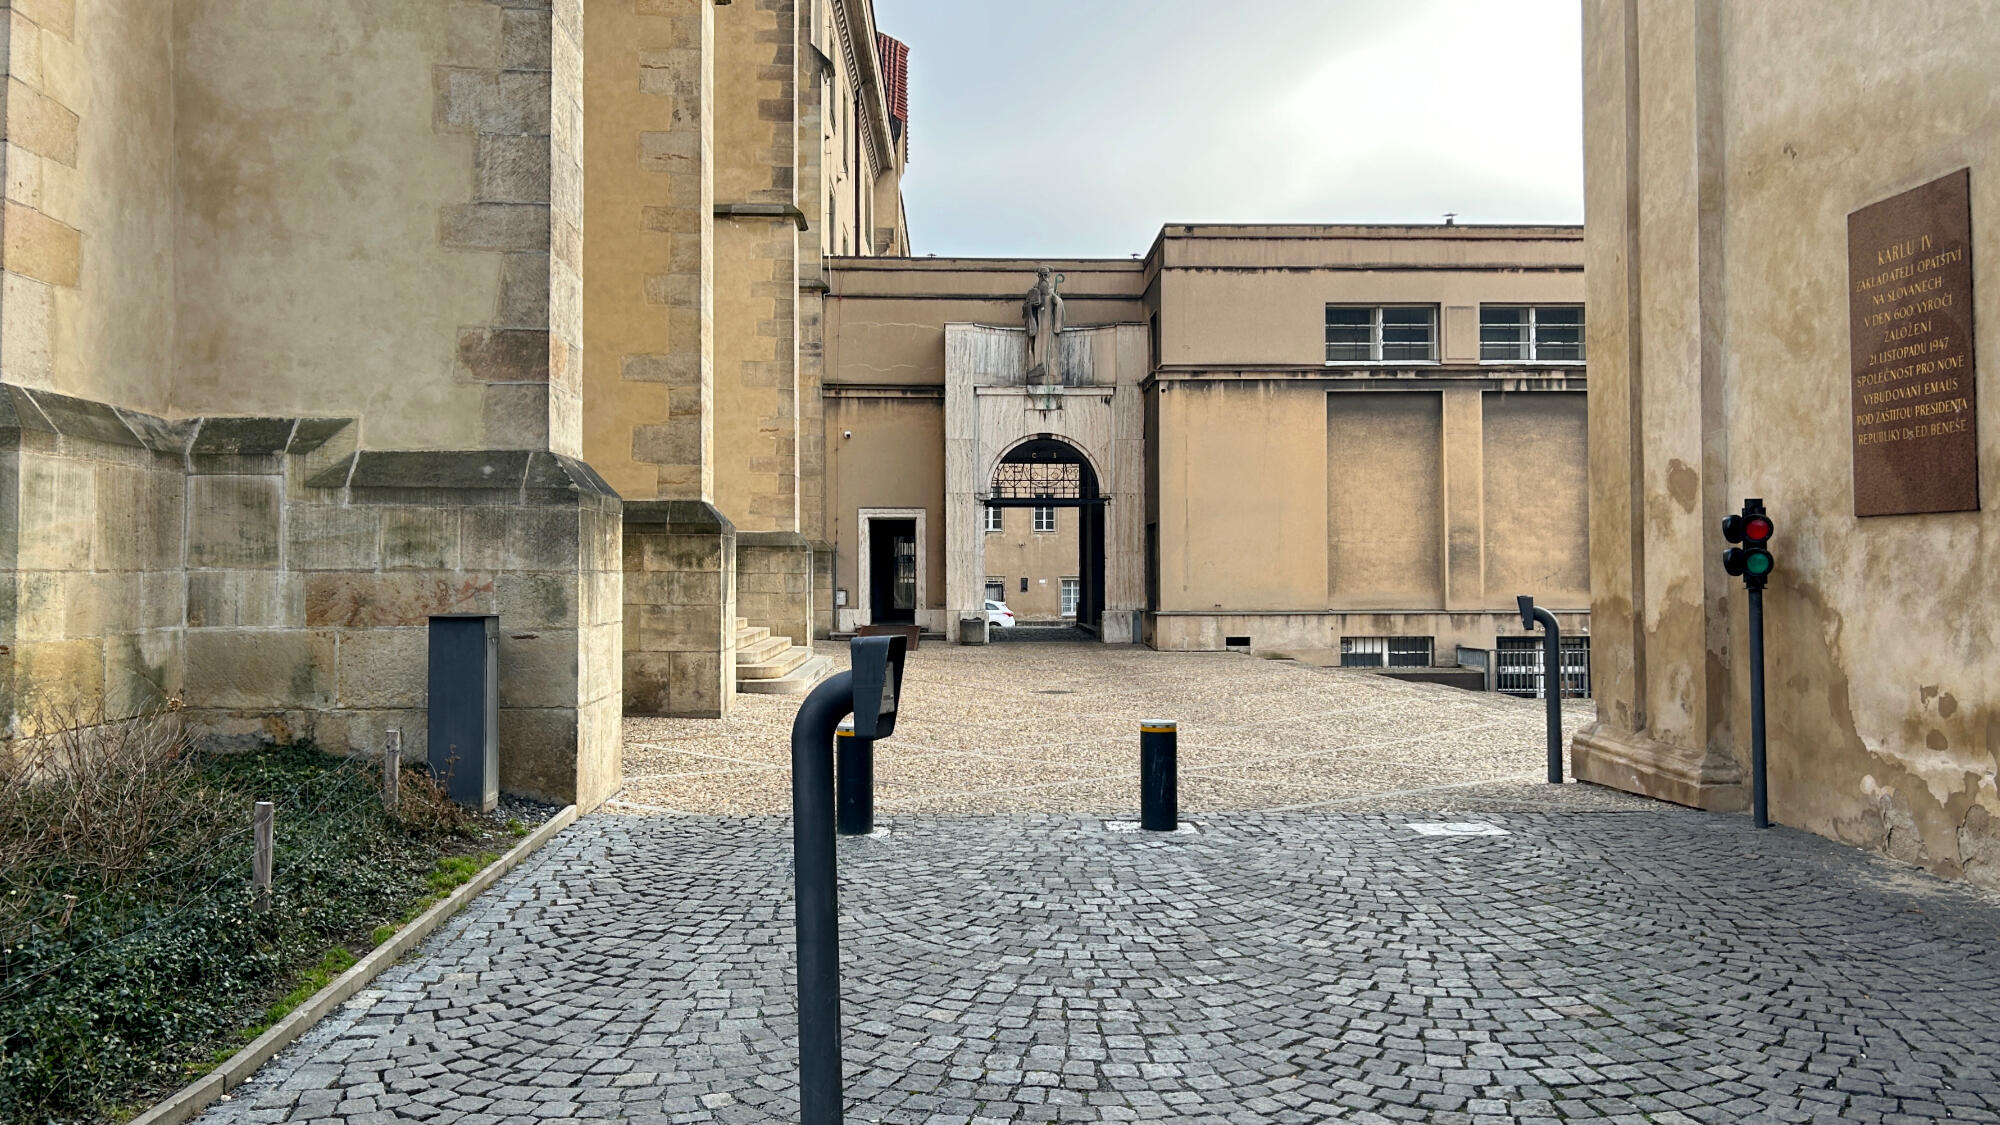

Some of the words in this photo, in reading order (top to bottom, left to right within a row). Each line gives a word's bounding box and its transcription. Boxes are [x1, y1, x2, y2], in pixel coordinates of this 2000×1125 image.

[1878, 239, 1915, 266] KARLU
[1856, 264, 1913, 293] ZAKLADATELI
[1887, 276, 1942, 302] SLOVANECH
[1872, 311, 1891, 327] DEN
[1894, 305, 1914, 319] 600
[1879, 342, 1927, 364] LISTOPADU
[1929, 337, 1949, 353] 1947
[1856, 366, 1913, 388] SPOLEČNOST
[1916, 361, 1935, 376] PRO
[1924, 377, 1959, 396] EMAUS
[1856, 412, 1874, 426] POD
[1915, 397, 1968, 417] PRESIDENTA
[1858, 428, 1902, 446] REPUBLIKY
[1930, 417, 1968, 436] BENEŠE
